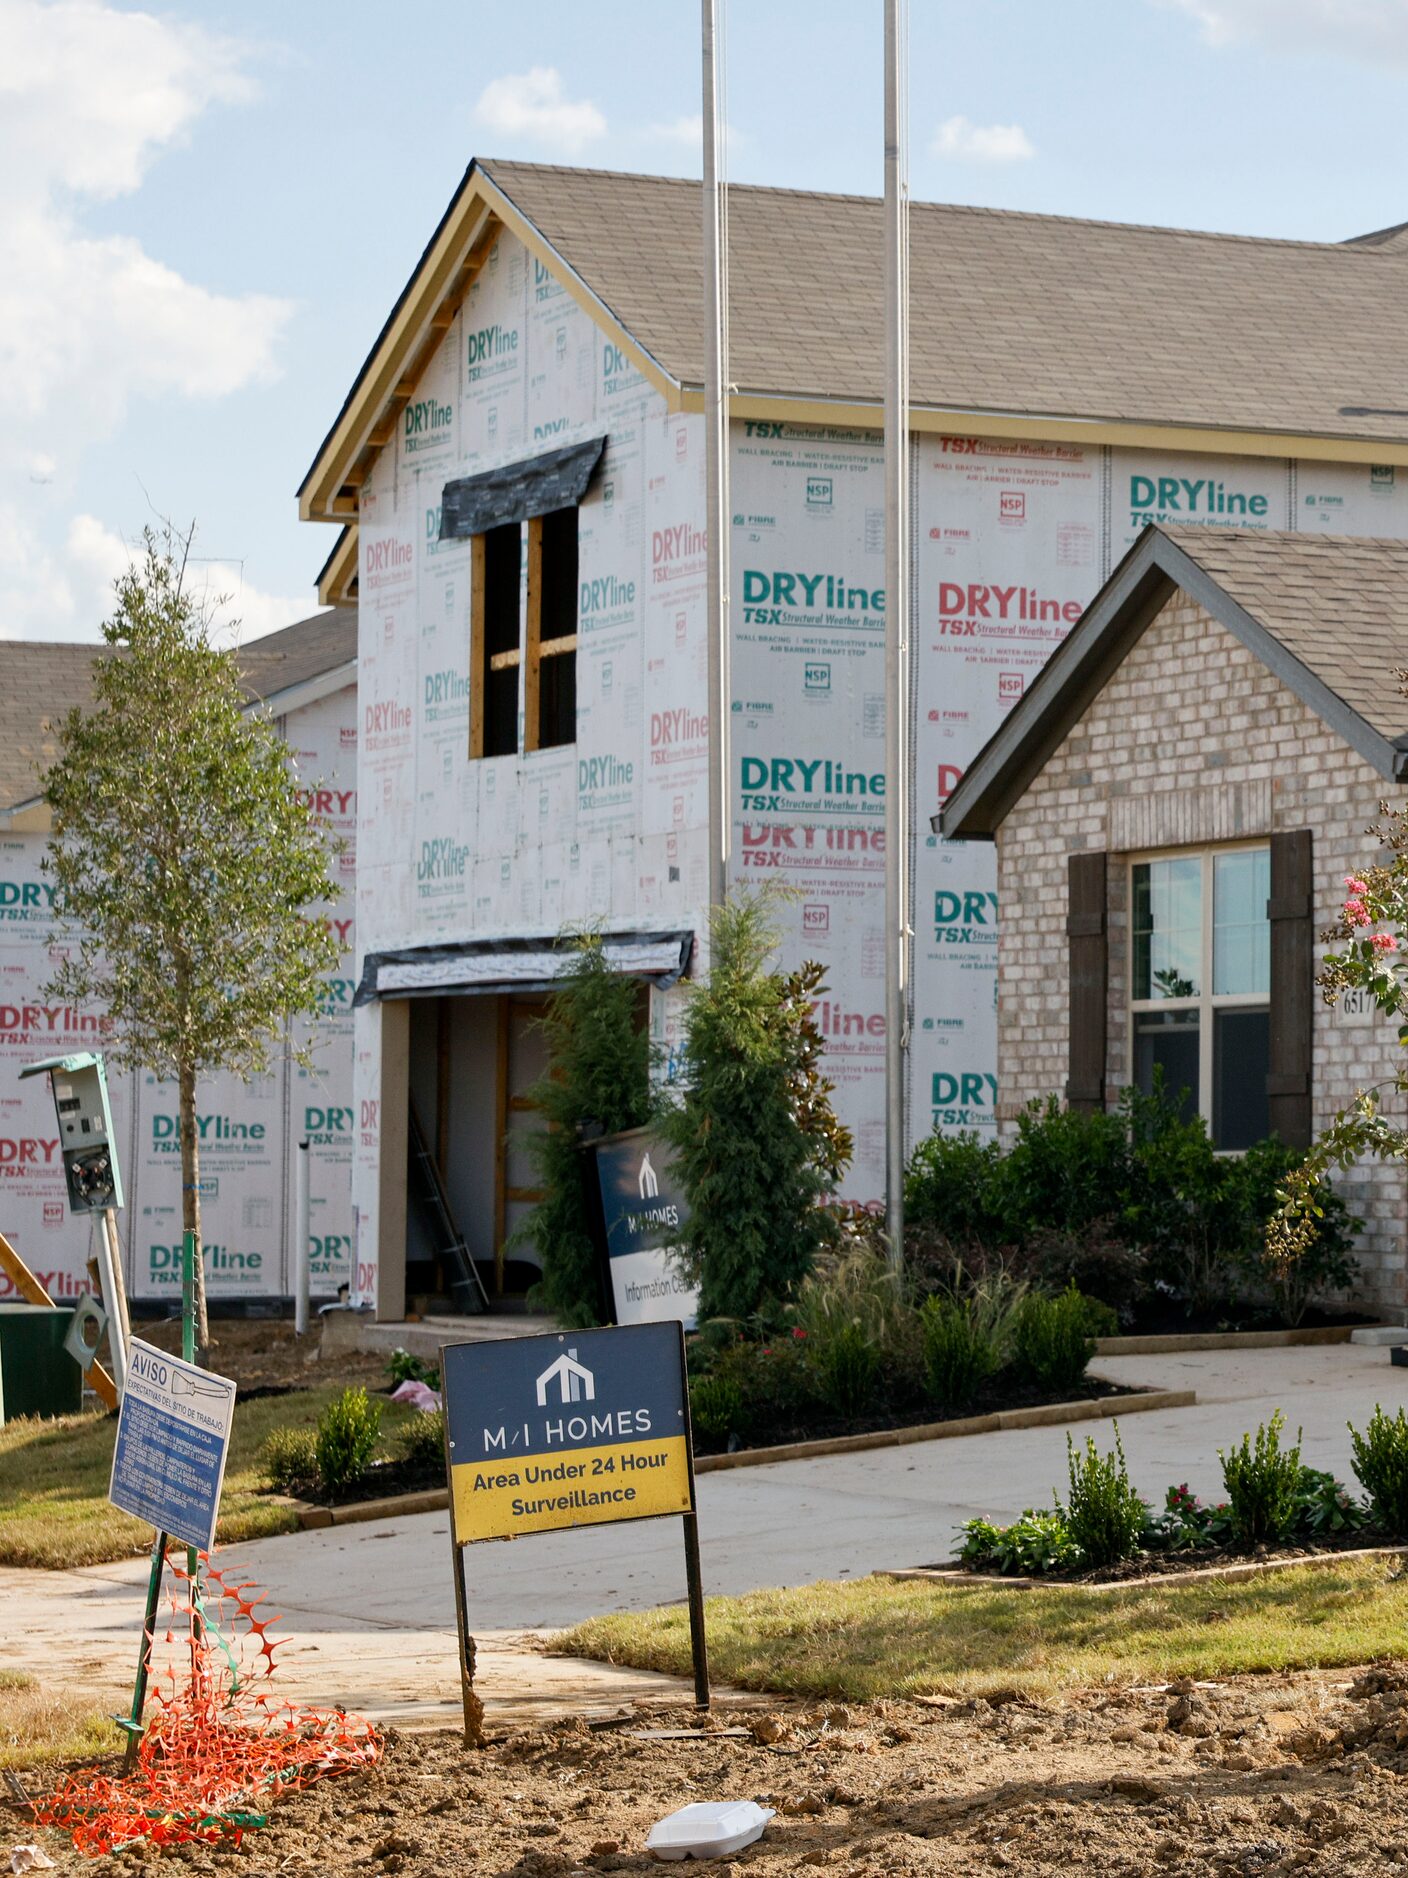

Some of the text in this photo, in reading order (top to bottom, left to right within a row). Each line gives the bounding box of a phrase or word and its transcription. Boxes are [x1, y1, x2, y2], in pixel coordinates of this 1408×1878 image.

[468, 325, 518, 364] DRYline
[405, 399, 452, 436] DRYline
[744, 421, 783, 439] TSX
[826, 428, 862, 443] Weather
[737, 447, 757, 456] WALL
[760, 449, 793, 458] BRACING
[940, 437, 1083, 458] TSX Structural Weather Barrier
[771, 459, 868, 473] AIR BARRIER DRAFT STOP
[934, 463, 953, 471] WALL
[1372, 465, 1392, 477] NSP
[807, 484, 829, 497] NSP
[1016, 477, 1039, 486] DRAFT
[1041, 479, 1059, 487] STOP
[1000, 499, 1022, 511] NSP
[1130, 475, 1268, 516] DRYline
[653, 523, 708, 565] DRYline
[367, 539, 412, 573] DRYline
[581, 575, 635, 614] DRYline
[743, 570, 885, 611] DRYline
[939, 582, 1083, 622] DRYline
[743, 608, 860, 627] TSX Structural Weather
[939, 619, 1053, 637] TSX Structural Weather
[736, 633, 865, 648] WALL BRACING WATER-RESISTIVE
[932, 644, 952, 652] WALL
[770, 645, 866, 657] AIR BARRIER DRAFT STOP
[1015, 658, 1037, 666] DRAFT
[805, 670, 827, 683] NSP
[1000, 679, 1021, 691] NSP
[425, 670, 471, 705] DRYline
[366, 703, 411, 734] DRYline
[651, 707, 709, 747] DRYline
[579, 754, 633, 792] DRYline
[741, 757, 885, 796] DRYline
[741, 794, 858, 812] TSX Structural Weather
[742, 850, 860, 869] TSX Structural Weather
[801, 879, 865, 889] WATER-RESISTIVE
[820, 889, 845, 898] DRAFT
[804, 911, 826, 923] NSP
[934, 927, 973, 944] TSX
[1344, 991, 1372, 1014] 6517
[0, 1006, 114, 1033] DRYline
[937, 1018, 964, 1027] FIBRE
[931, 1109, 970, 1125] TSX
[153, 1115, 265, 1140] DYline
[152, 1141, 181, 1153] TSX
[624, 1277, 671, 1302] Information
[131, 1353, 167, 1386] AVISO
[127, 1378, 225, 1433] EXPECTATIVAS DEL SITIO DE TRABAJO:
[546, 1409, 652, 1444] HOMES
[473, 1452, 668, 1491] Area Under 24 Hour
[511, 1487, 636, 1516] Surveillance
